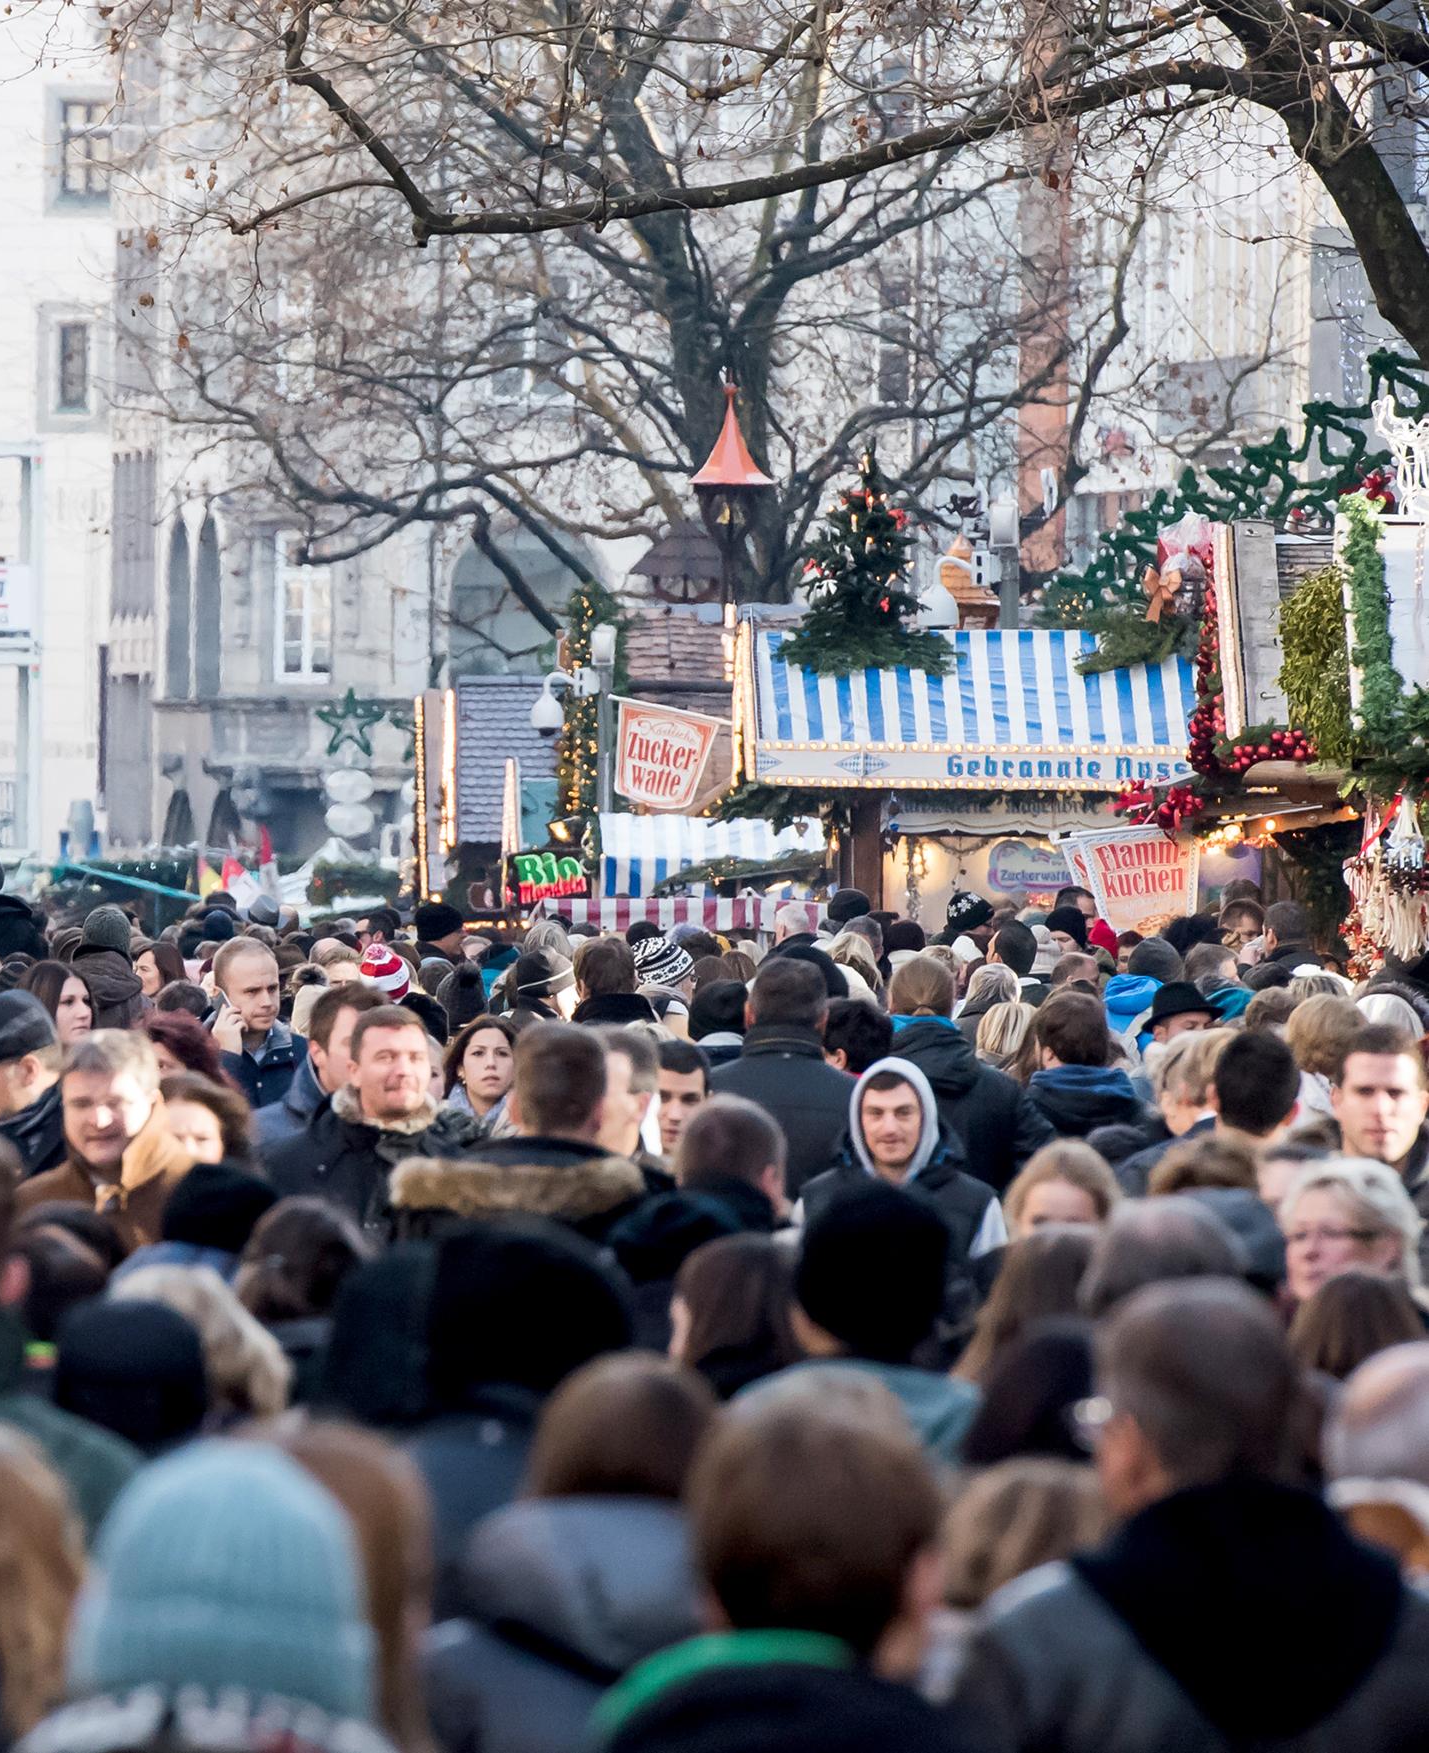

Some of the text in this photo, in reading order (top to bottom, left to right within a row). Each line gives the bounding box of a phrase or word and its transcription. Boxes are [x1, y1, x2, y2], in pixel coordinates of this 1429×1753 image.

[627, 731, 699, 770] Zucker-
[946, 754, 1102, 780] Gebrannte
[631, 764, 682, 797] watte
[513, 852, 583, 886] Bio
[1094, 839, 1190, 872] Flamm-
[1100, 866, 1185, 898] kuchen
